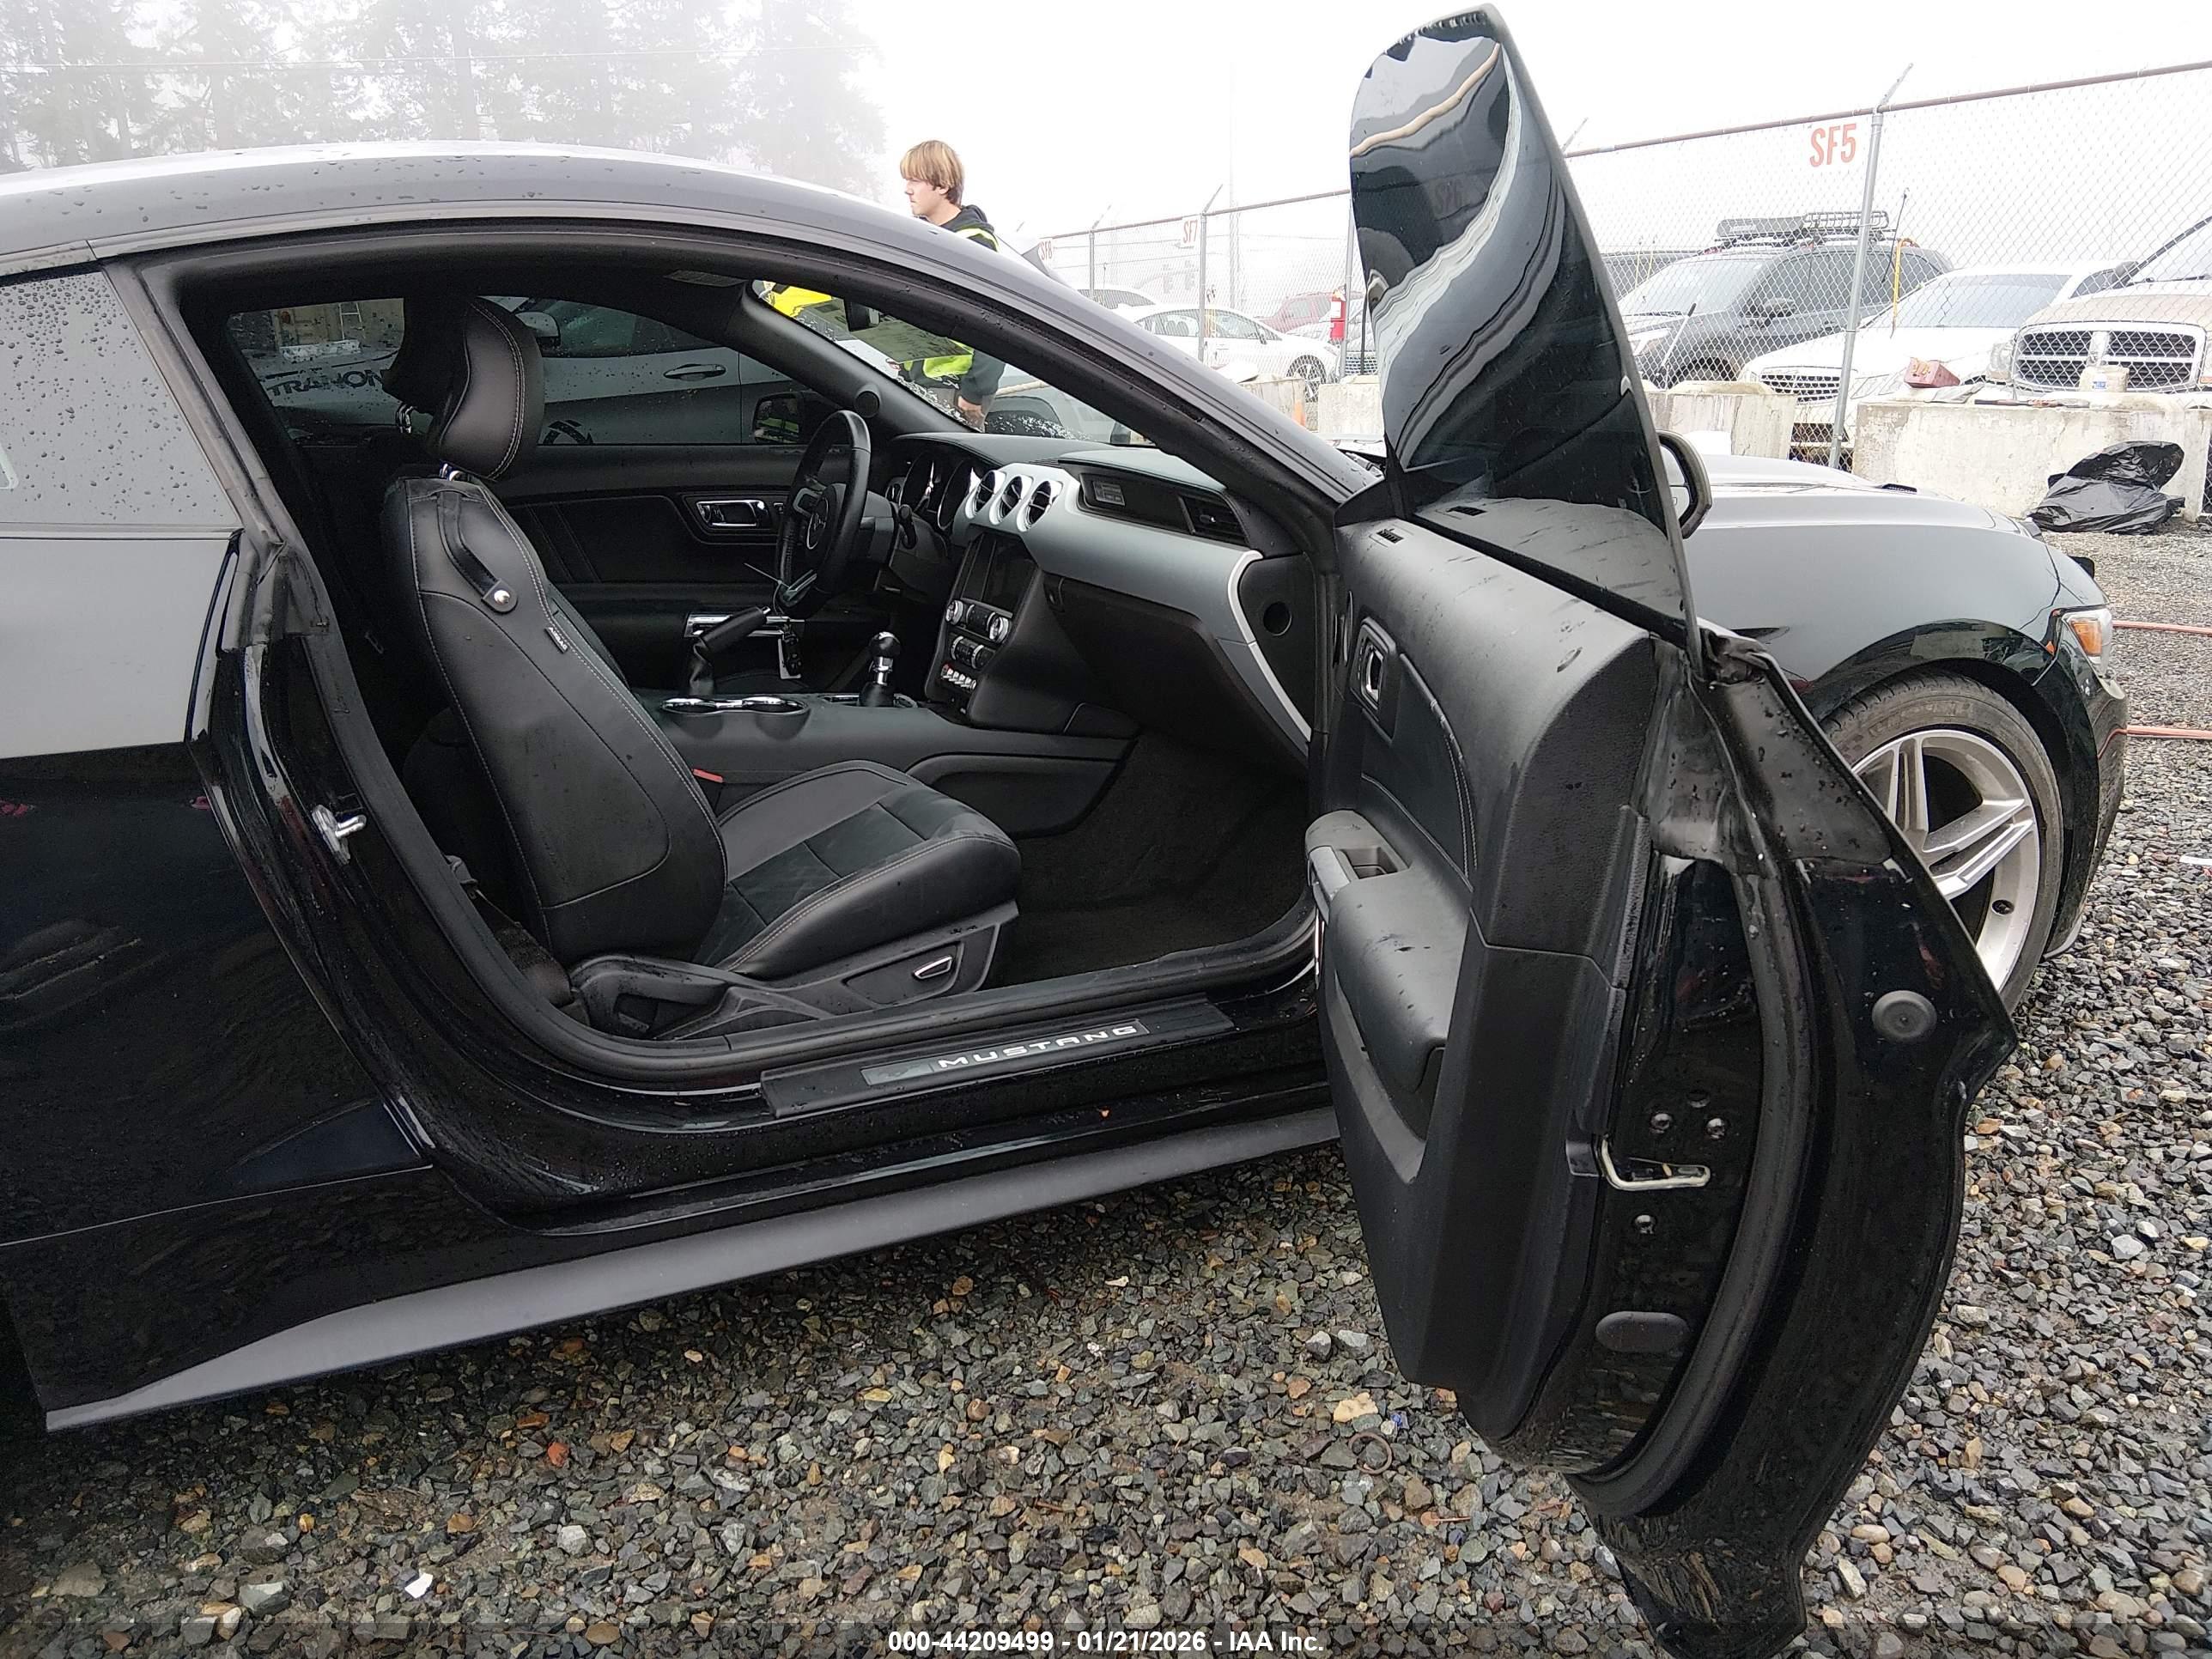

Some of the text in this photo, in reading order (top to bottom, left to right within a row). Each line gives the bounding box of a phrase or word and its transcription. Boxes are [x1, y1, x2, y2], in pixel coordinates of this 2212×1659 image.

[1809, 123, 1857, 167] SF5
[1182, 220, 1199, 244] SF7
[938, 1025, 1138, 1069] MUSTANG
